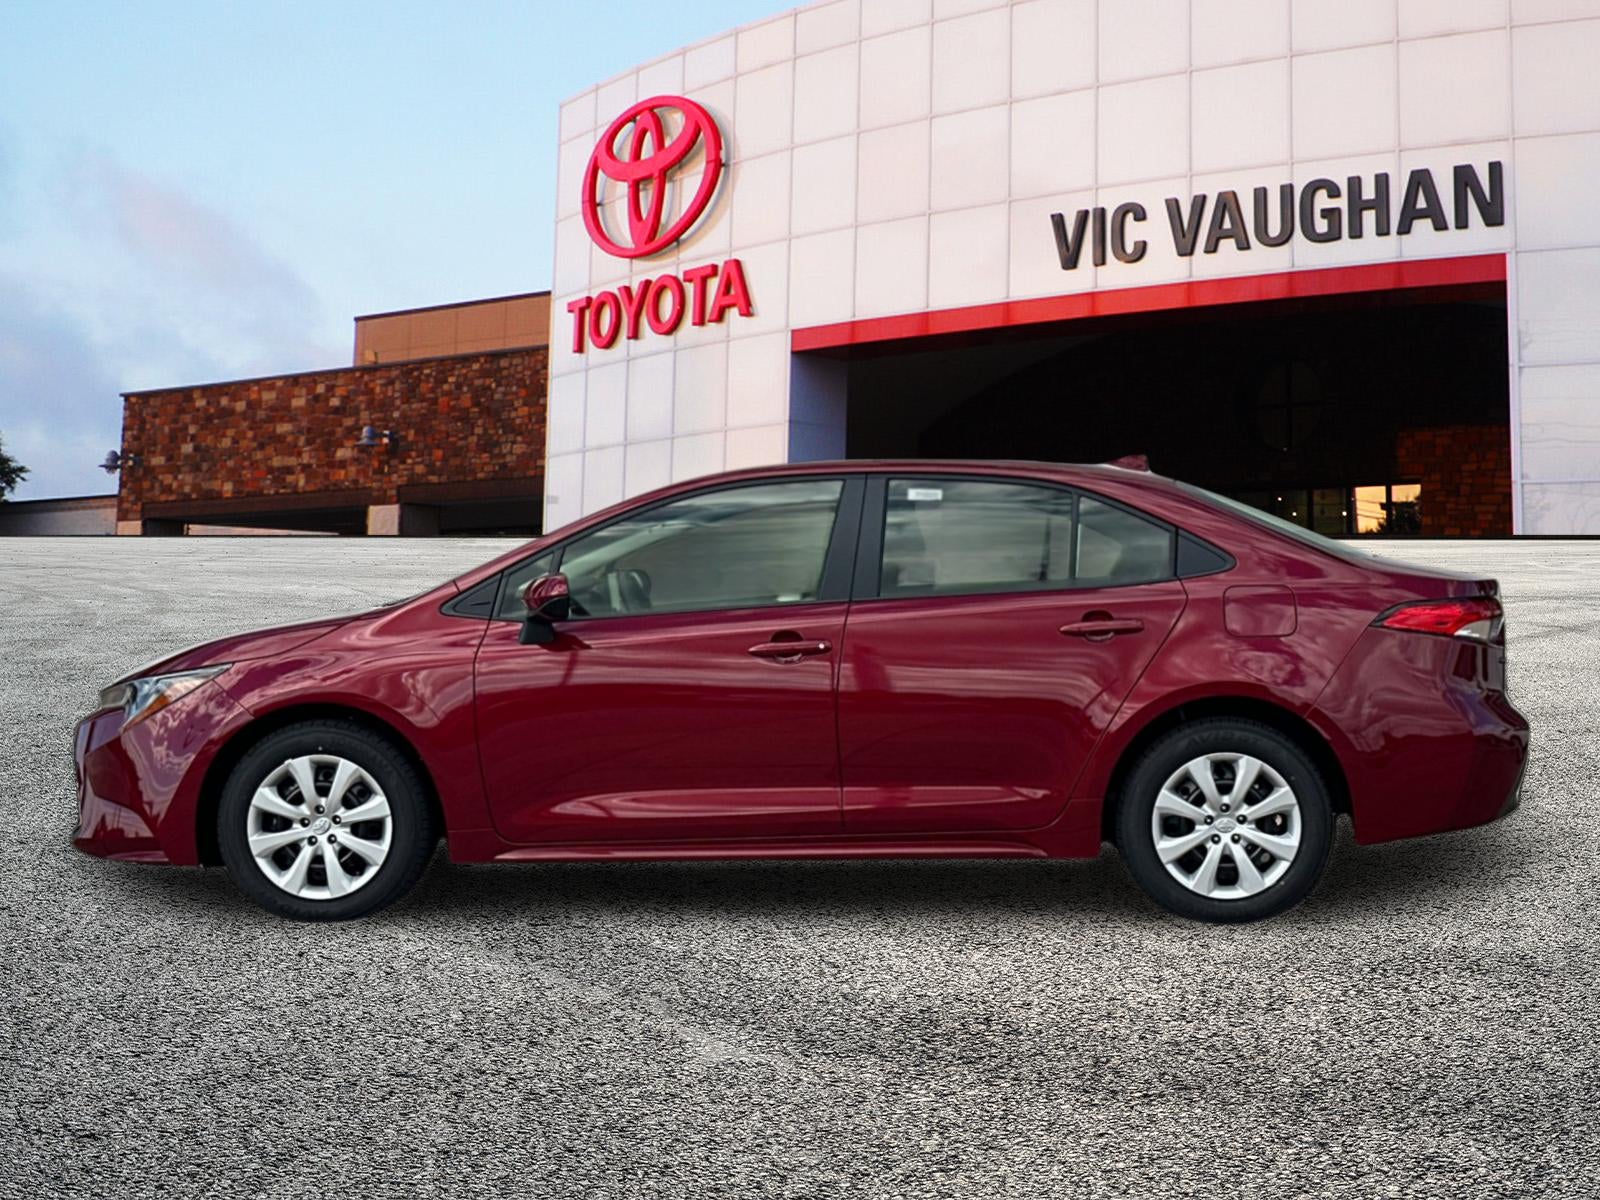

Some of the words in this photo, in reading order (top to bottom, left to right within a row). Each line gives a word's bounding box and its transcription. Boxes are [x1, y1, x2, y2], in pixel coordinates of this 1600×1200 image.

[1050, 202, 1147, 270] VIC
[1165, 161, 1504, 257] VAUGHAN
[567, 259, 754, 353] TOYOTA
